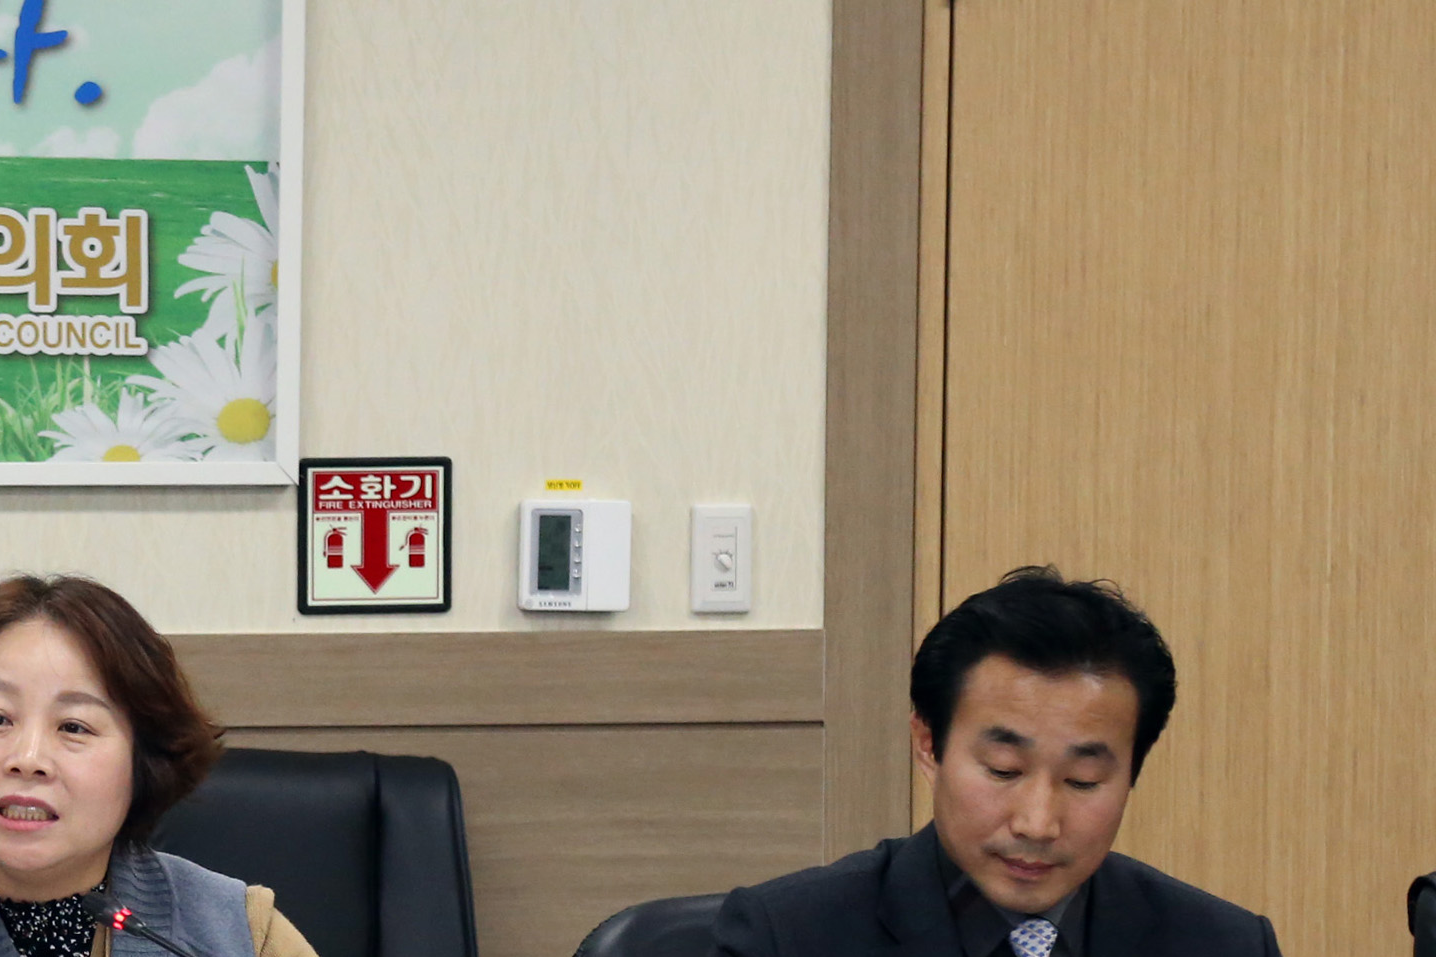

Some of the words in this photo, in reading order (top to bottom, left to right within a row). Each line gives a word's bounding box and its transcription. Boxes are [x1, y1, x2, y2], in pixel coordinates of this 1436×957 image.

[318, 474, 433, 500] 소화기
[318, 500, 344, 510] FIRE
[348, 500, 432, 509] EXTINGUISHER
